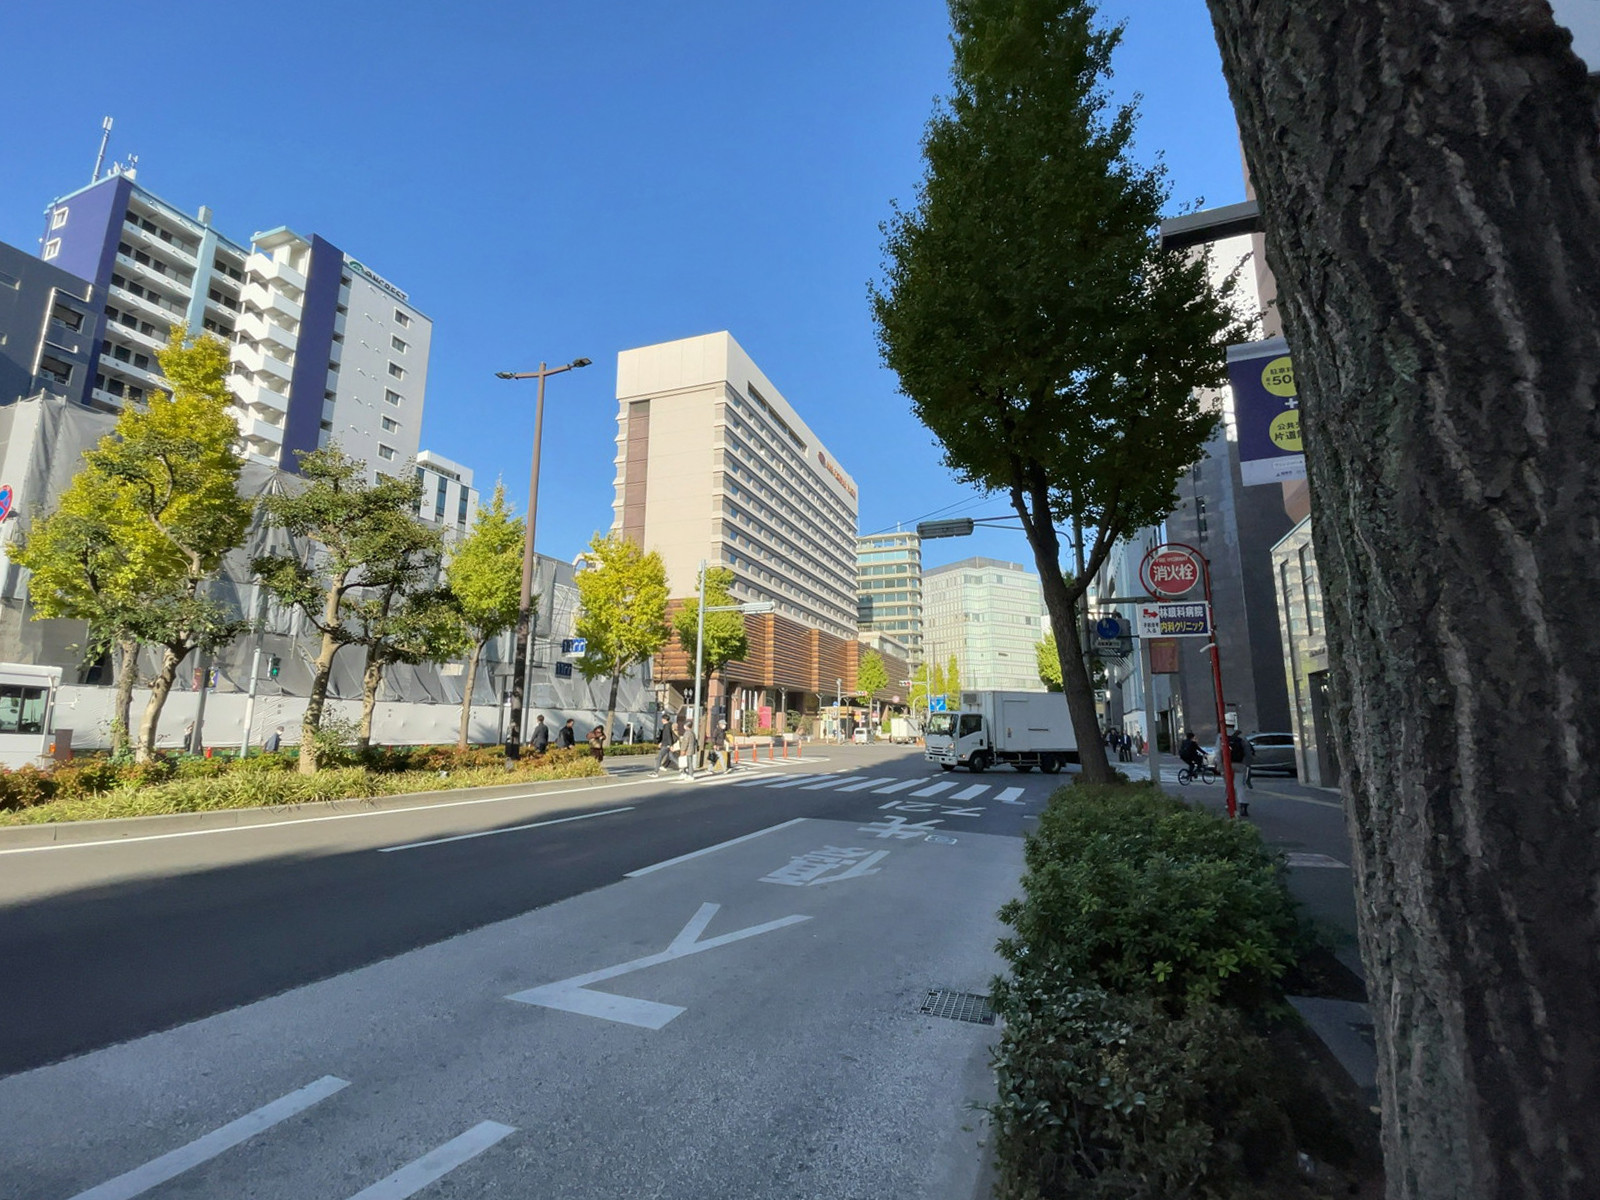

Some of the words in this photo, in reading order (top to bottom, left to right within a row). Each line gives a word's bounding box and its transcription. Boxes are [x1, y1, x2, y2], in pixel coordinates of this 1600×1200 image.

[1153, 563, 1194, 582] 消火栓
[1160, 605, 1204, 618] 林眼科病院
[1161, 621, 1204, 633] 内科クリニック
